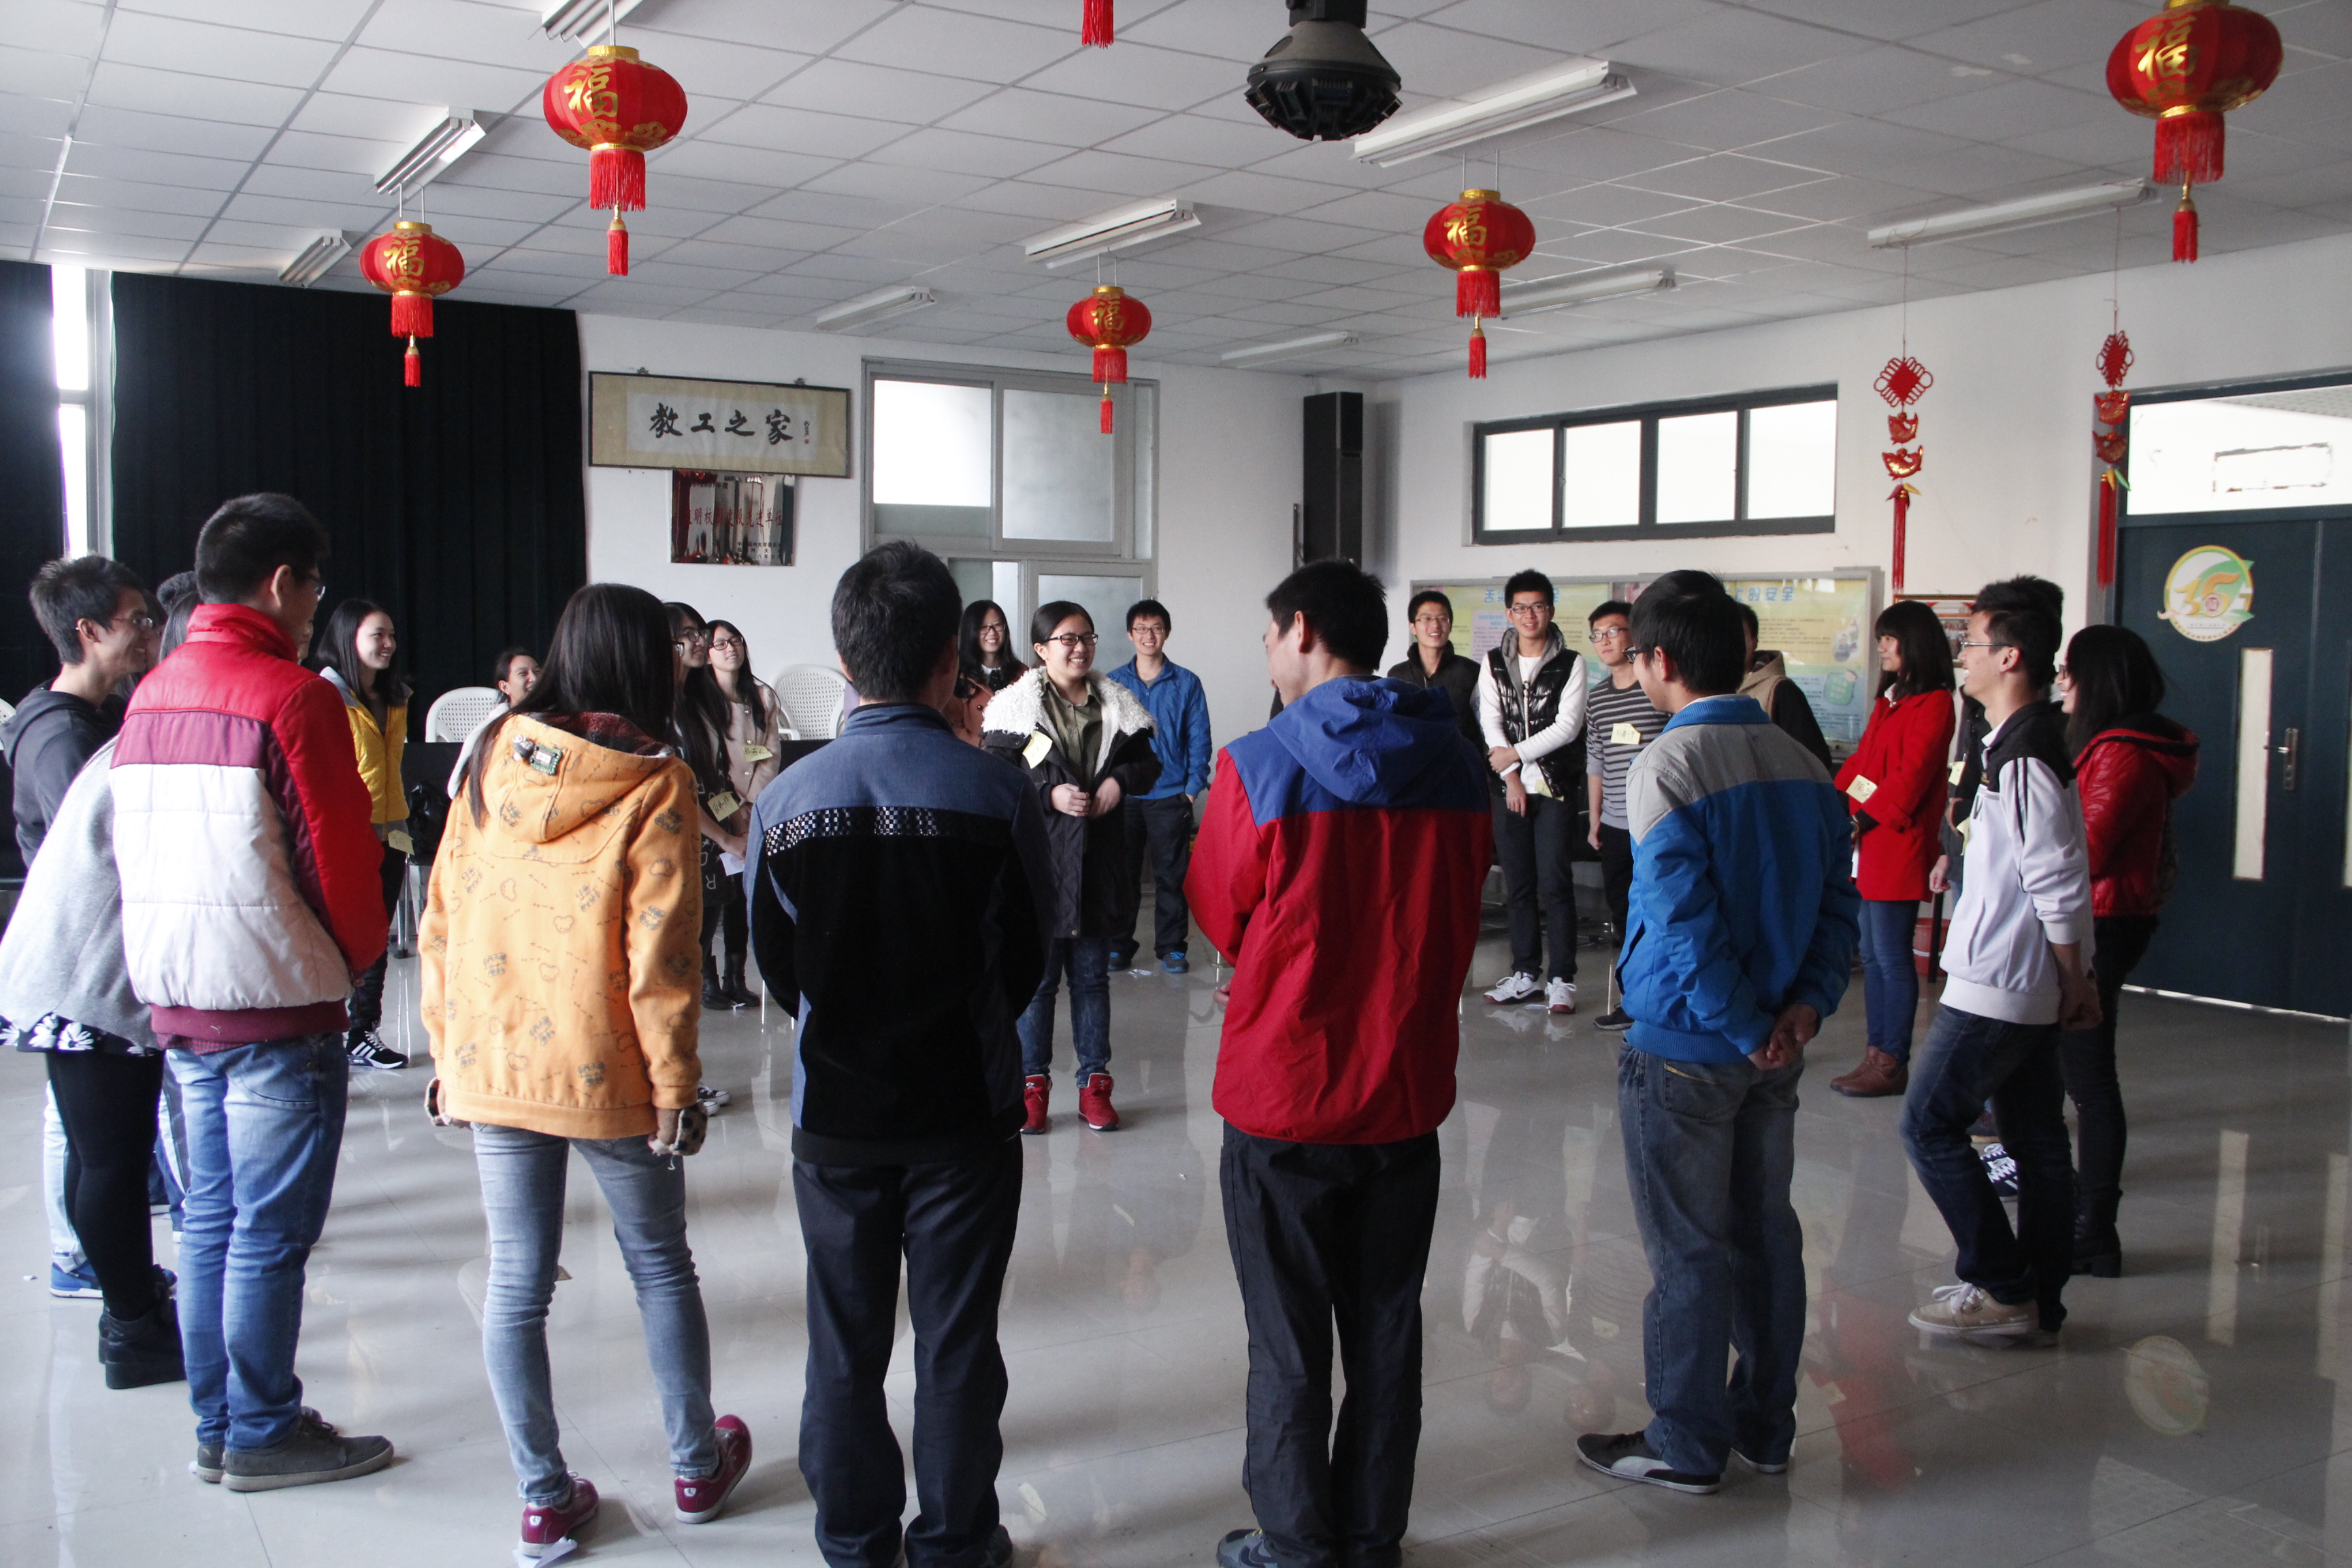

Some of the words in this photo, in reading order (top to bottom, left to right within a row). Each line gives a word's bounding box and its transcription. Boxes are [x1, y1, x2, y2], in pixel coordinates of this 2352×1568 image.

[2135, 15, 2200, 80] 福
[564, 66, 619, 118] 福
[1443, 206, 1487, 246] 福
[383, 239, 424, 277] 福
[1090, 299, 1126, 332] 福
[649, 402, 793, 445] 教工之家
[1725, 586, 1795, 602] 上的安全
